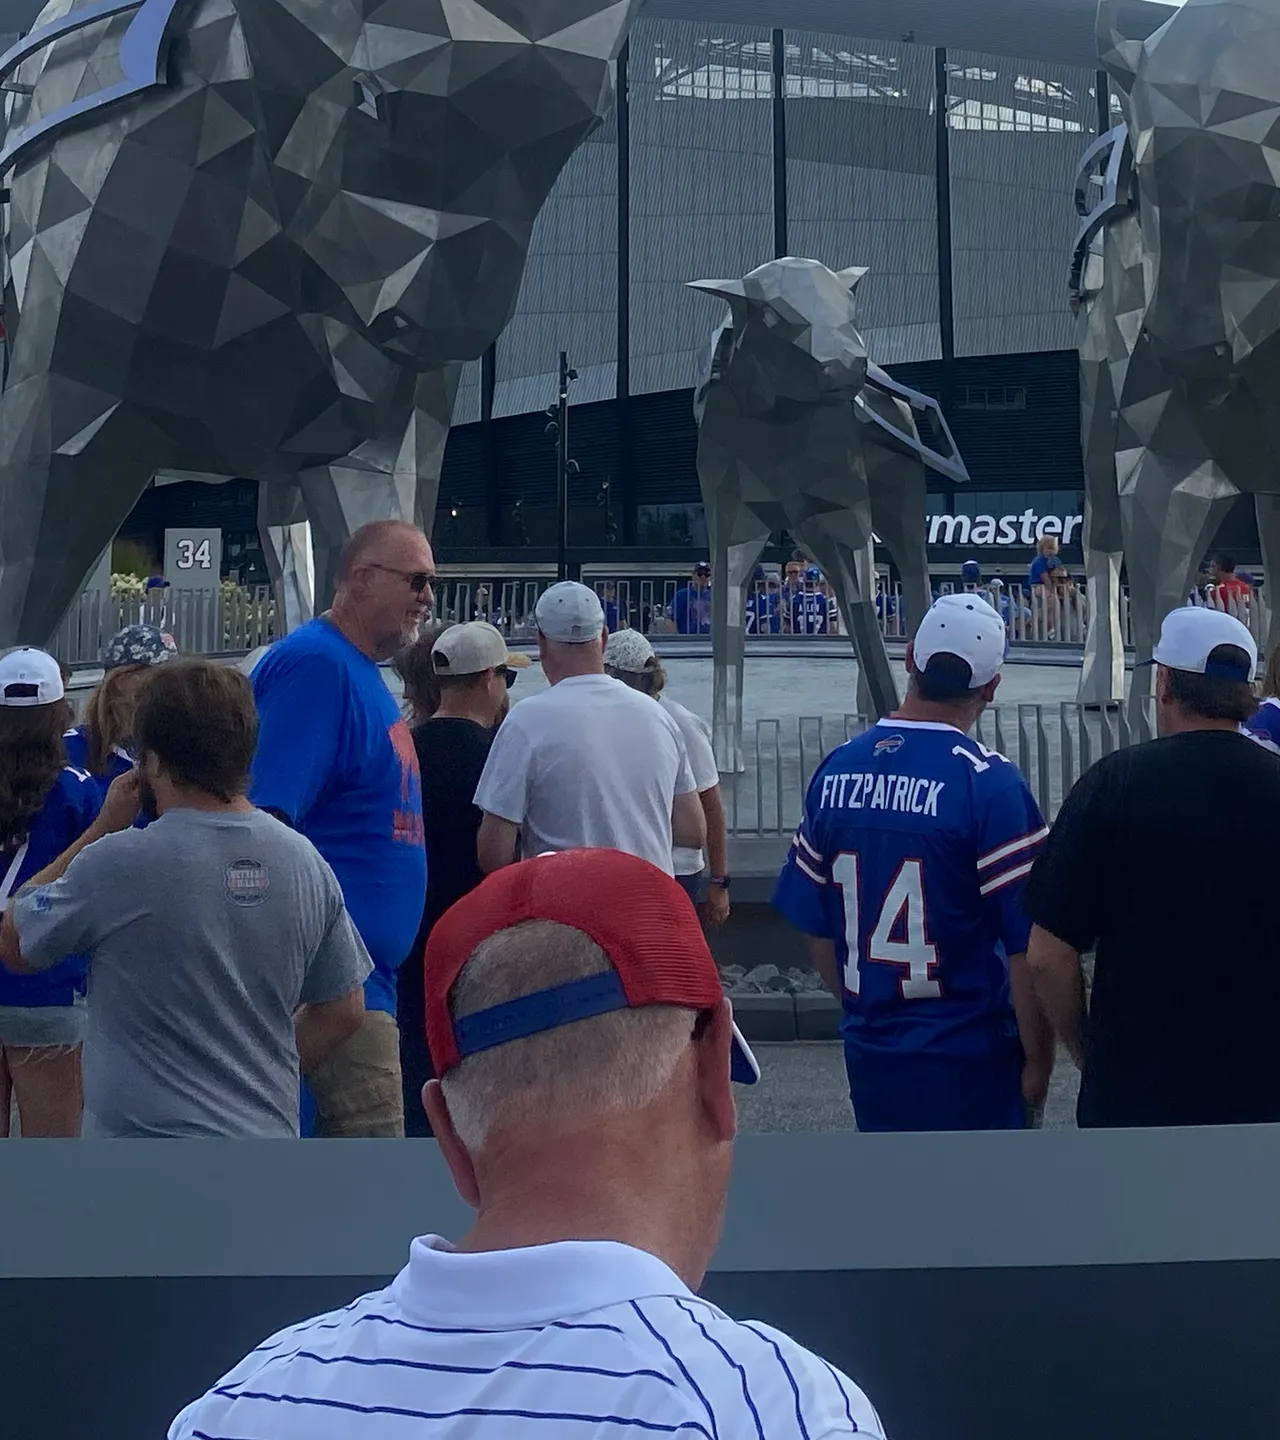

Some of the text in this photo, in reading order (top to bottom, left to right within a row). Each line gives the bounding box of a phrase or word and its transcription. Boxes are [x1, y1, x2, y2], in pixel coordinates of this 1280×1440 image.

[926, 508, 1083, 544] master
[177, 538, 211, 569] 34
[820, 773, 945, 817] FITZPATRICK
[831, 850, 944, 1000] 14
